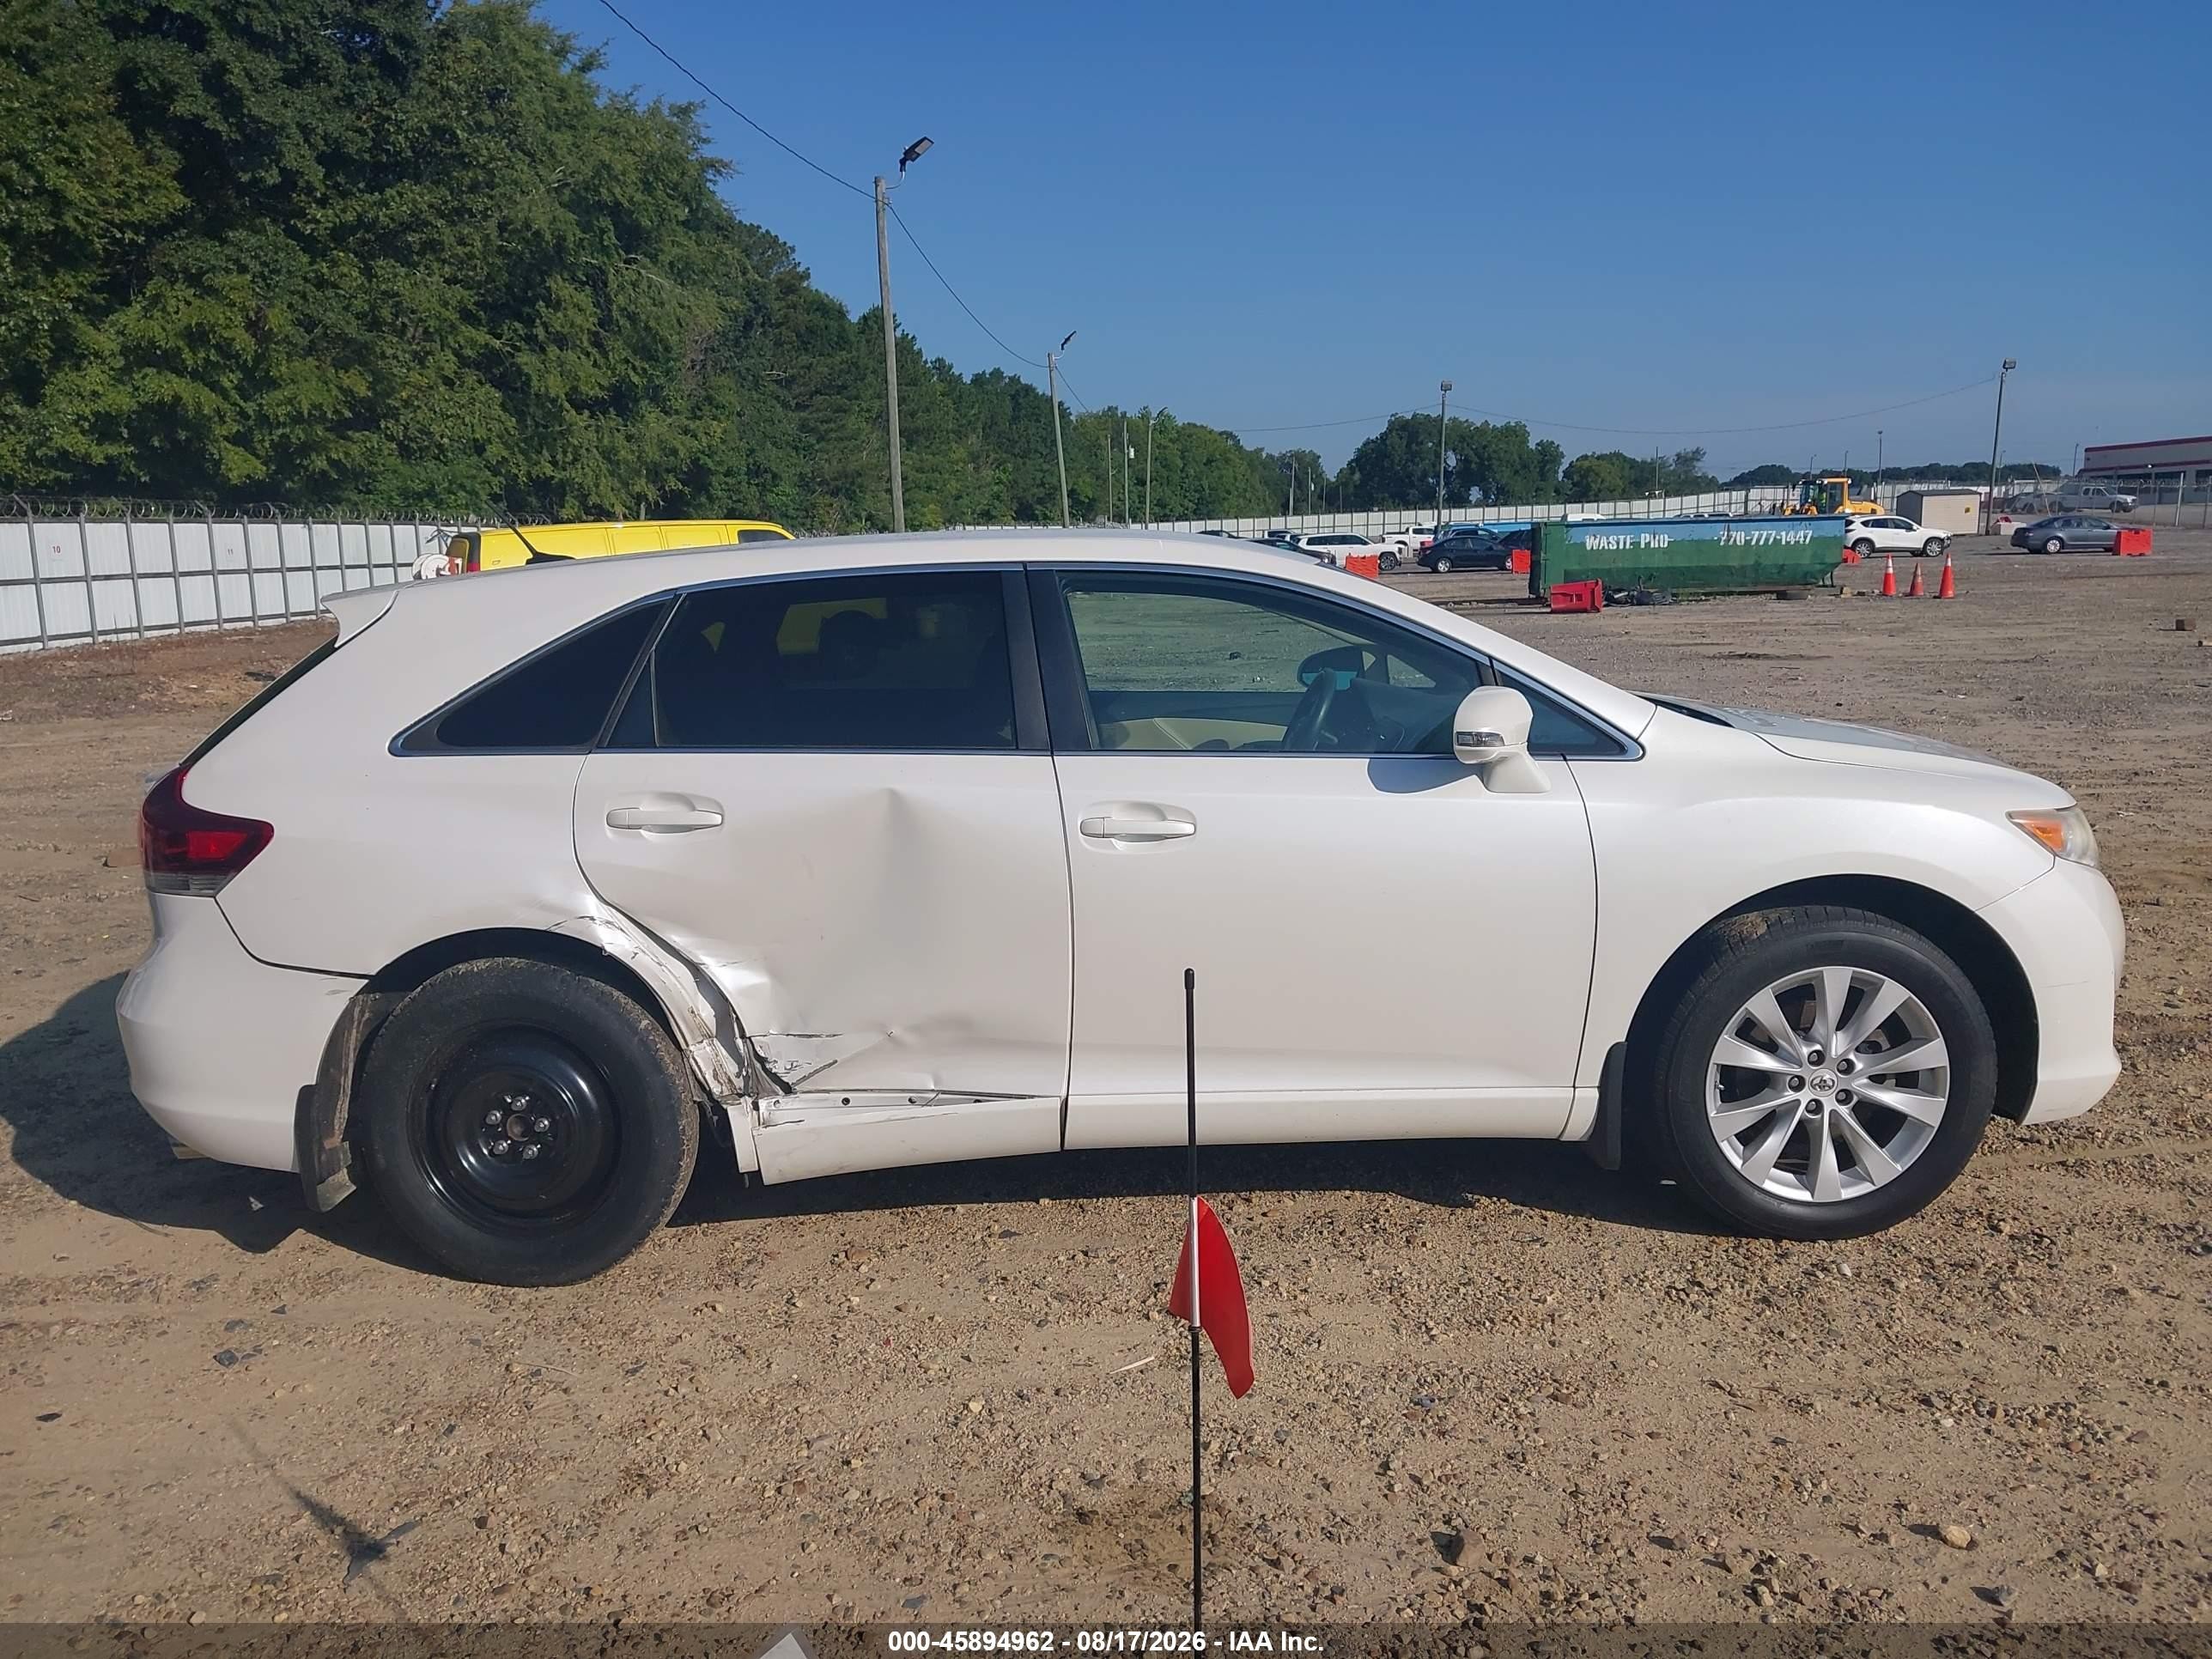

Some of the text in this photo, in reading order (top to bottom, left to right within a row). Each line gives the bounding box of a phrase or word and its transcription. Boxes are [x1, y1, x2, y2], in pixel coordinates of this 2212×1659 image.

[1585, 535, 1634, 550] WASTE
[1719, 530, 1813, 545] 770-777-1447
[52, 545, 61, 554] 10
